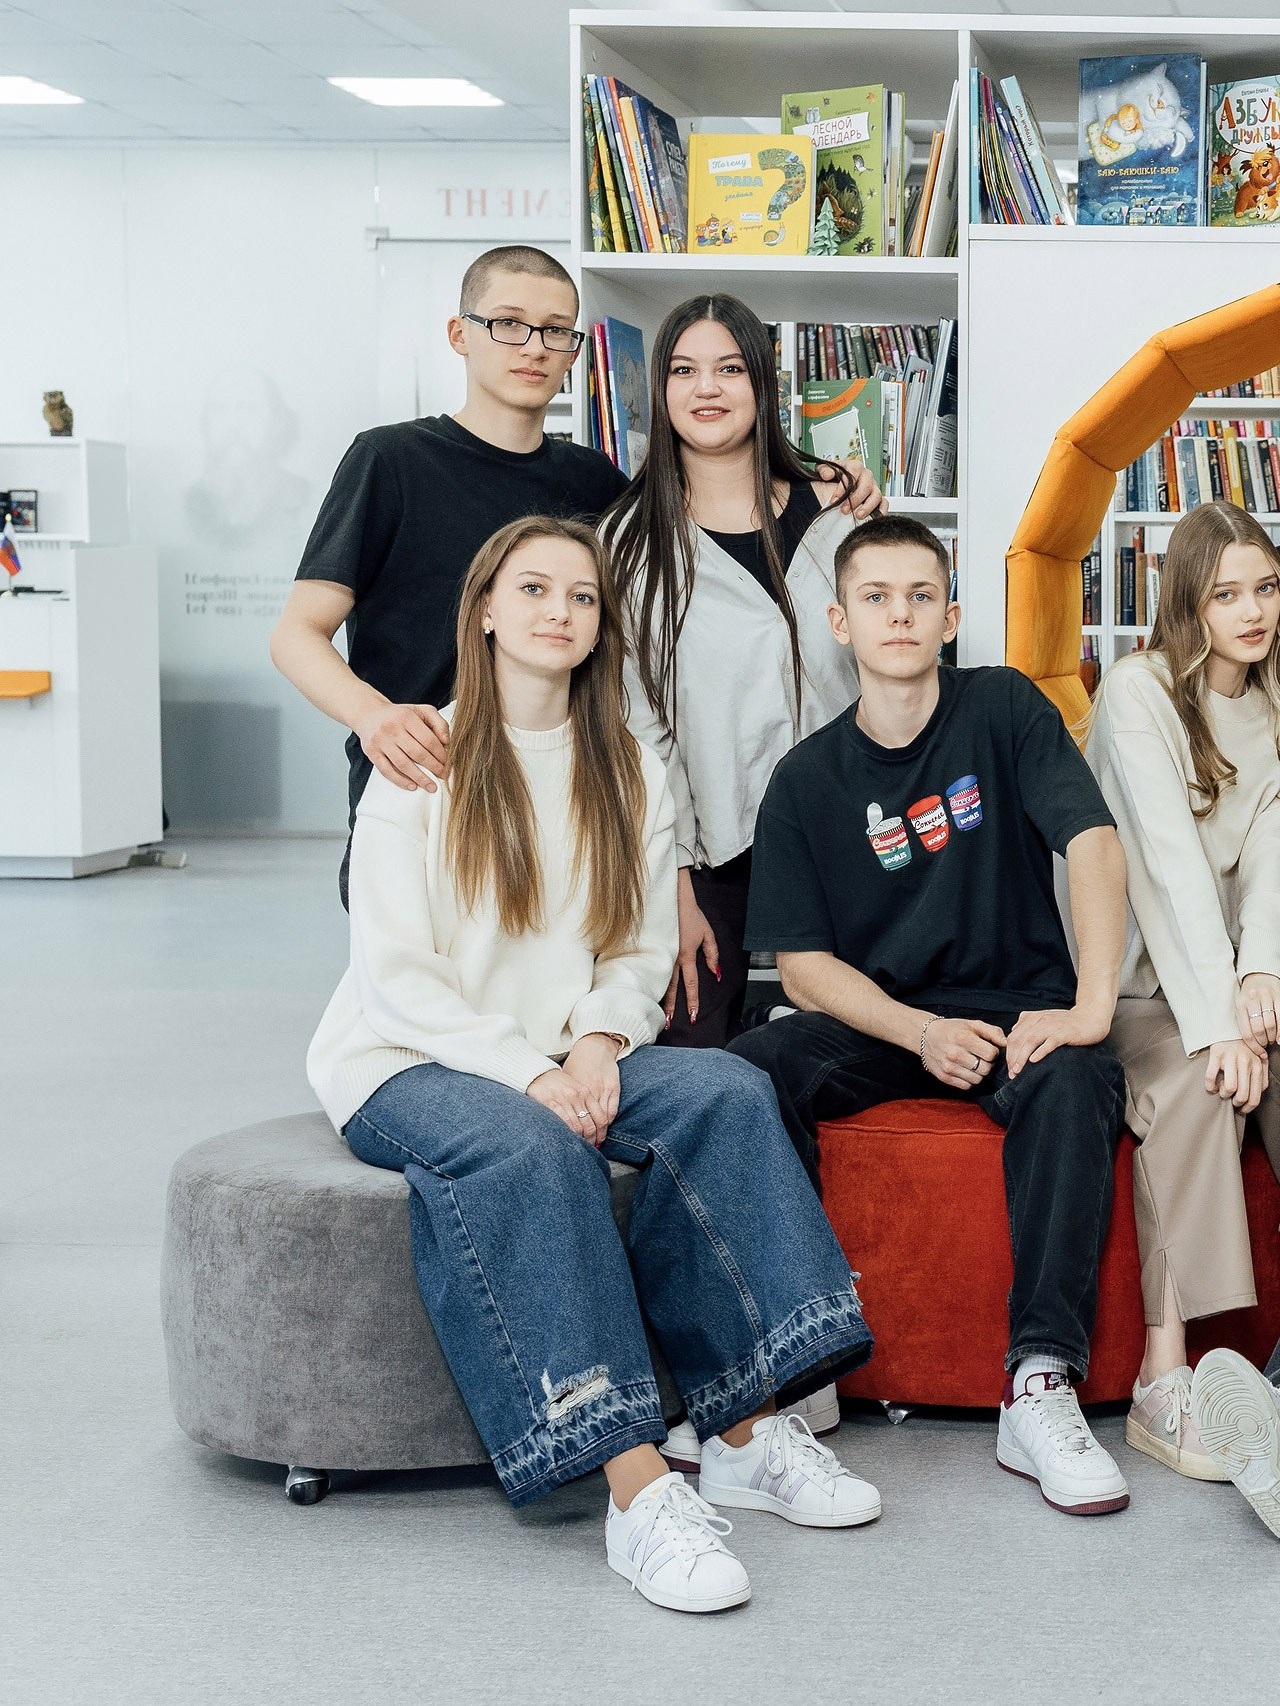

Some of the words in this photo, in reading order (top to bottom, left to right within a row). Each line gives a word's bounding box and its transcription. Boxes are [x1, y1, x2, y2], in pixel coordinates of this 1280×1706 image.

[812, 116, 852, 135] ЛЕСНОЙ
[1021, 120, 1034, 146] Который
[811, 130, 862, 147] АЛЕНДАРЬ
[633, 141, 644, 165] ИСТОРИИ
[712, 159, 747, 169] Почему
[1097, 166, 1179, 177] БАЮ-БАЮШКИ-БАЮ
[639, 167, 652, 207] КОСМИЧЕСКИЕ
[715, 175, 763, 187] ТРАВА
[914, 812, 944, 830] Converse
